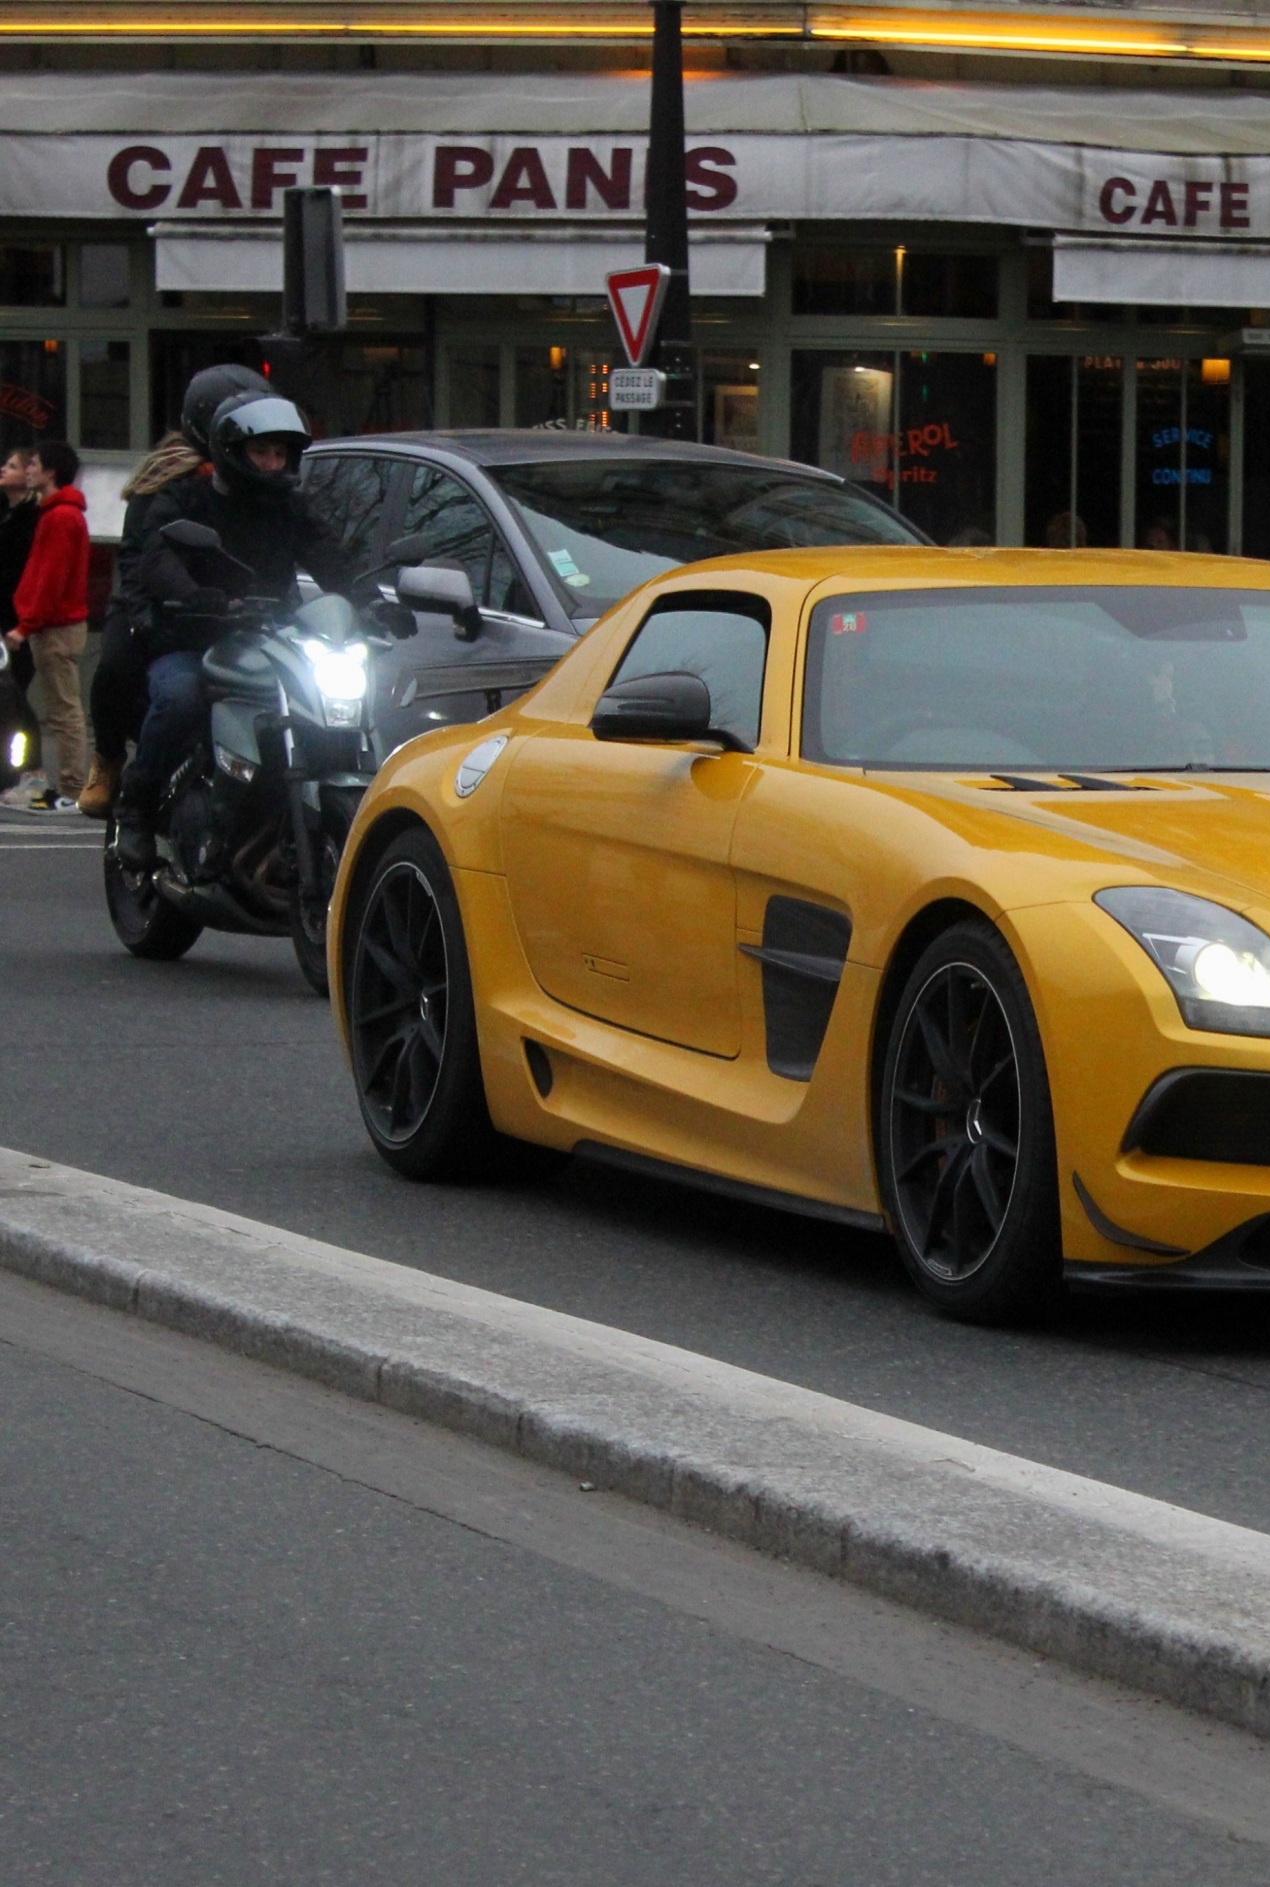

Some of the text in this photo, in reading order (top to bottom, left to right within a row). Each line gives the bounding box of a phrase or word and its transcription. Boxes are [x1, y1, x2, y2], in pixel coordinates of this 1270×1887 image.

[107, 146, 737, 211] CAFE PANS
[1100, 177, 1250, 228] CAFE
